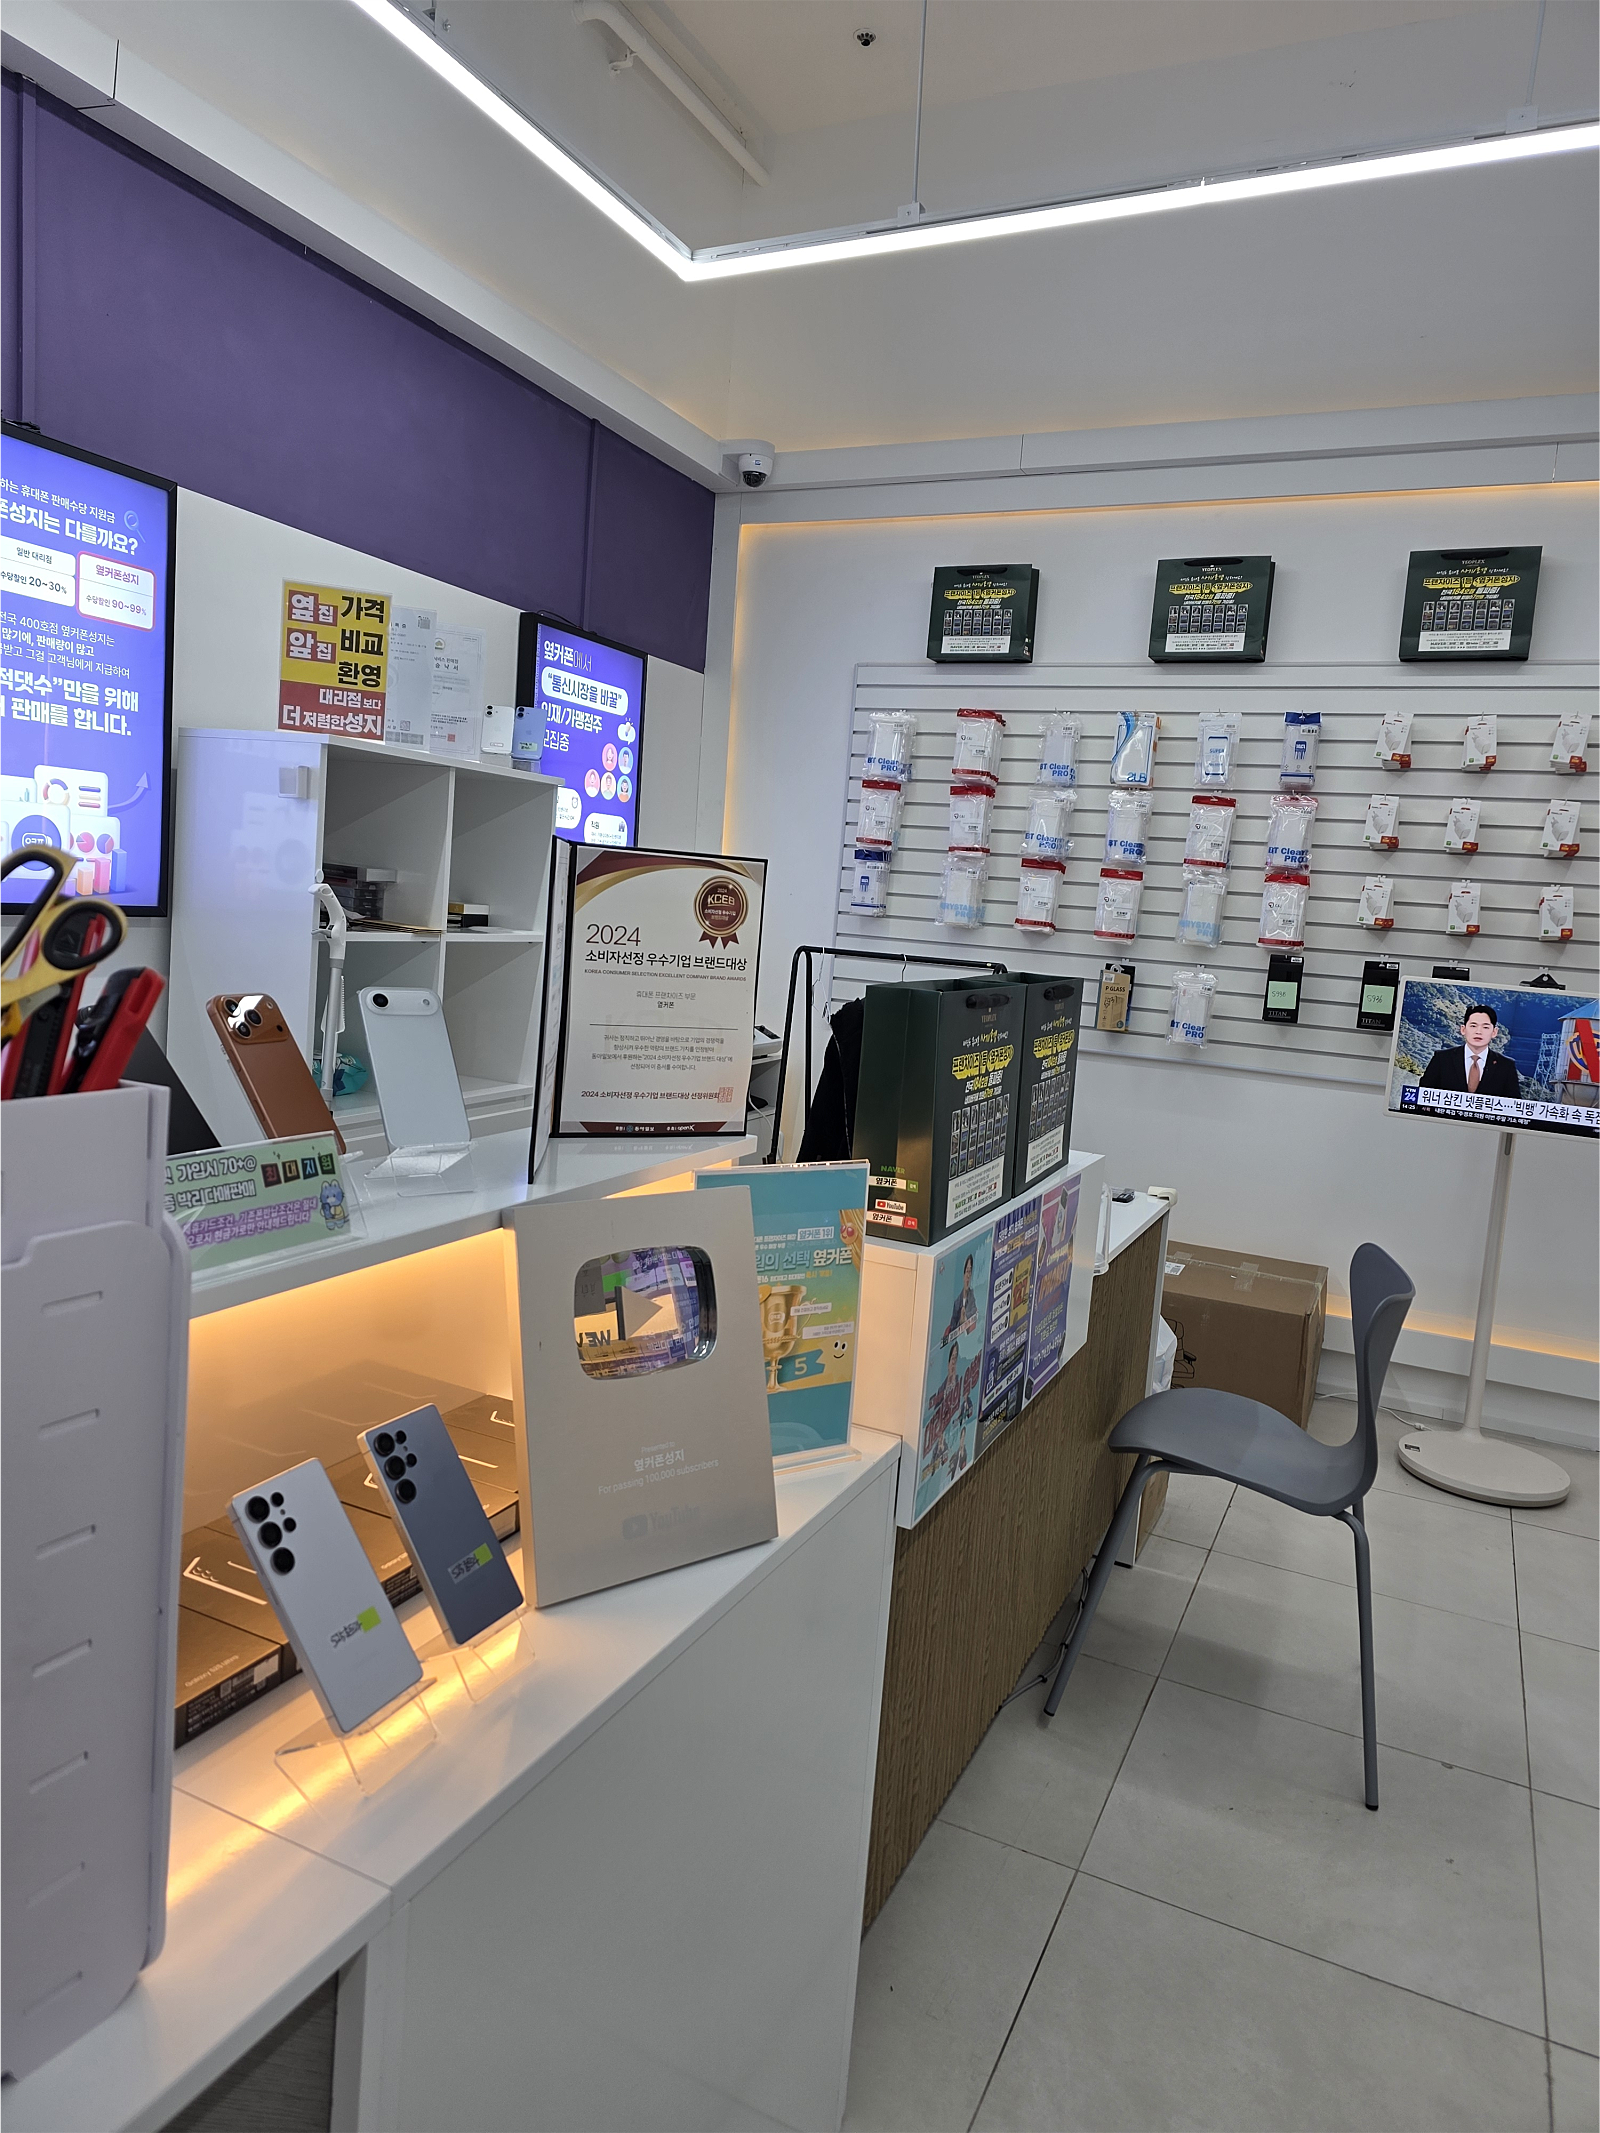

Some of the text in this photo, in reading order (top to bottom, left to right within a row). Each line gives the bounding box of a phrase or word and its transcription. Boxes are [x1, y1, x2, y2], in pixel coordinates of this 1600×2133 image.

[21, 484, 49, 503] 휴대폰
[51, 494, 87, 515] 판매수당
[89, 505, 115, 523] 지원금
[65, 518, 138, 555] 다를까요?
[32, 552, 52, 564] 대리점
[29, 576, 67, 594] 20~30%
[96, 564, 139, 586] 옆커폰성지
[112, 600, 147, 616] 90~99%
[291, 593, 385, 624] 옆집 가격
[2, 627, 94, 657] 많기에, 판매량이 많고
[19, 616, 58, 635] 400호점
[61, 625, 115, 647] 옆커폰성지는
[289, 628, 384, 661] 앞집 비교
[0, 643, 130, 679] 받고 그걸 고객님에게 지급하여
[544, 640, 592, 672] 옆커폰에서
[337, 661, 381, 687] 환영
[104, 687, 139, 712] 위해
[319, 688, 381, 710] 대리점 보다
[11, 697, 68, 727] 판매를
[73, 707, 132, 736] 합니다.
[283, 705, 382, 736] 더 저렴한 성지
[1049, 763, 1070, 771] Clear
[586, 923, 642, 947] 2024
[585, 950, 748, 971] 소비자선정 우수기업 브랜드대상
[1182, 1022, 1206, 1031] Clear
[1361, 1017, 1382, 1025] TITAN
[1185, 1030, 1204, 1039] PRO
[581, 1090, 599, 1098] 2024
[600, 1091, 632, 1099] 소비자선정
[633, 1092, 659, 1100] 우수기업
[659, 1092, 690, 1100] 브랜드대상
[1404, 1092, 1416, 1102] 24
[1422, 1090, 1441, 1104] 워너
[1443, 1092, 1463, 1108] 삼킨
[1539, 1104, 1569, 1121] 가속화
[1571, 1108, 1582, 1122] 속
[177, 1160, 220, 1181] 가입시
[881, 1166, 905, 1174] NAVER
[876, 1177, 897, 1186] 옆커폰
[178, 1179, 257, 1208] 박리다매판매
[887, 1202, 904, 1211] YouTube
[872, 1213, 892, 1223] 옆커폰
[799, 1228, 834, 1239] 옆커폰 1위
[783, 1247, 853, 1270] 선택 옆커폰
[795, 1358, 807, 1375] 5
[634, 1449, 685, 1472] 옆커폰성지
[598, 1458, 720, 1495] For passing 100,000 subscribers
